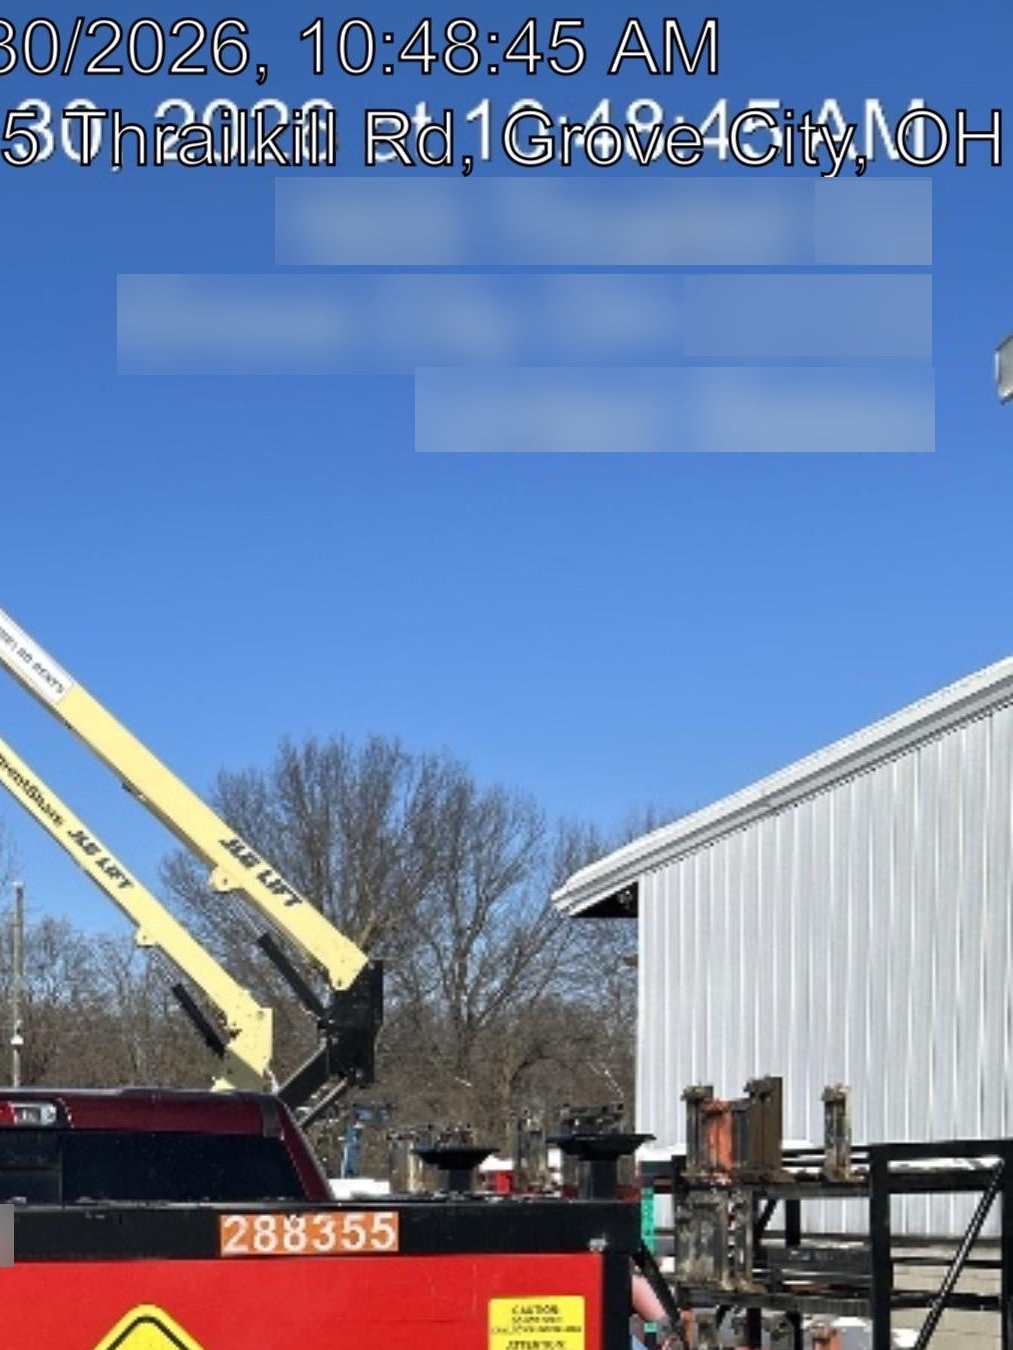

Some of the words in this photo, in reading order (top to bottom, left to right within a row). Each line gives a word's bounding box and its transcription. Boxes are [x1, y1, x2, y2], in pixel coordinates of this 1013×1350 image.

[218, 839, 261, 868] JLG
[256, 868, 303, 907] LIFT
[222, 1212, 397, 1254] 288355
